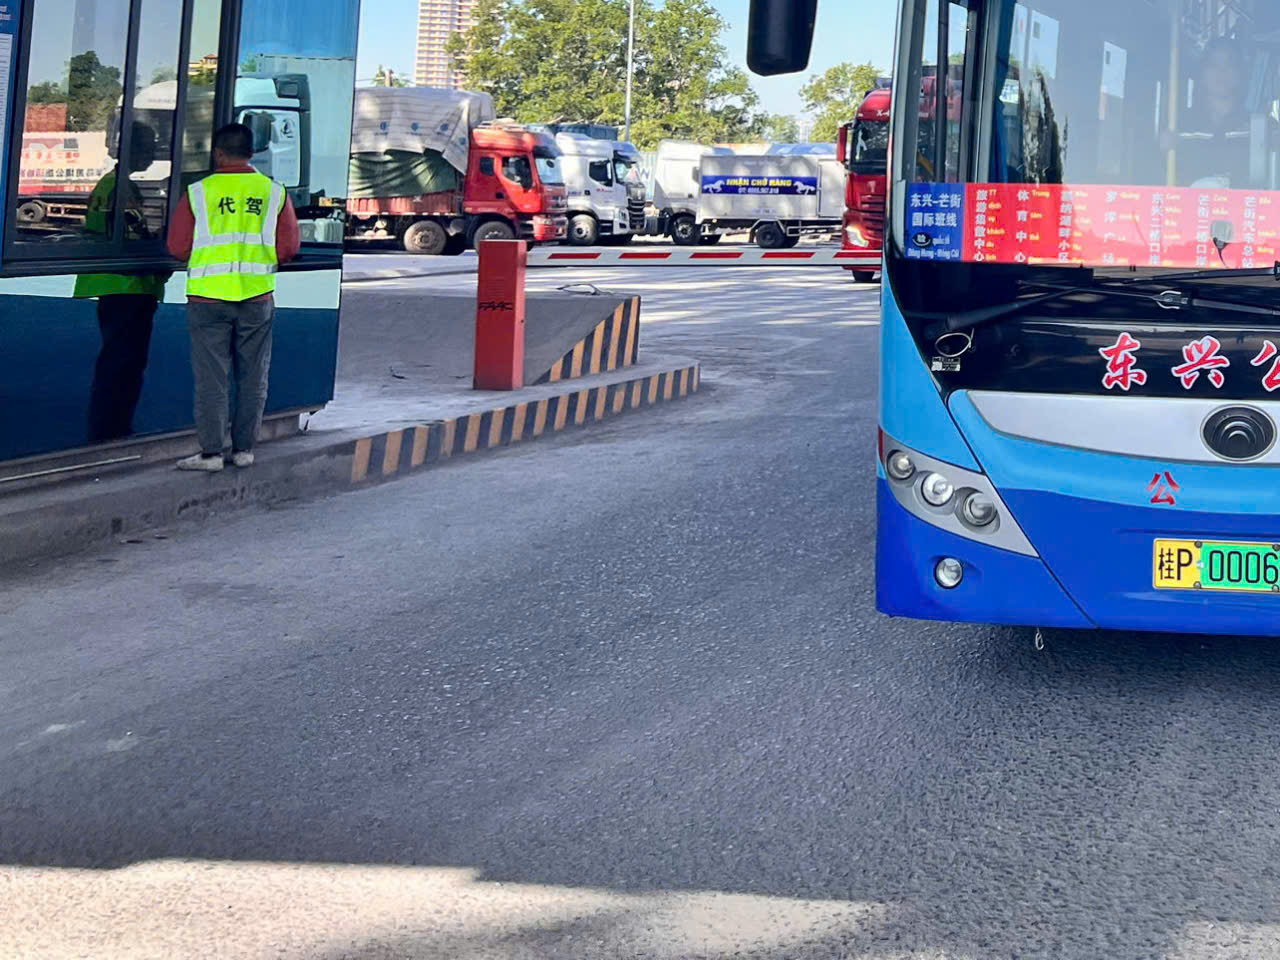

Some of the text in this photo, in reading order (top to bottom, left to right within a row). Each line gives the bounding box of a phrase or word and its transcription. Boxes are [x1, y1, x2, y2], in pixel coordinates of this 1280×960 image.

[218, 196, 262, 216] 代驾
[910, 193, 961, 208] 东兴-芒街
[911, 212, 957, 227] 国际班线
